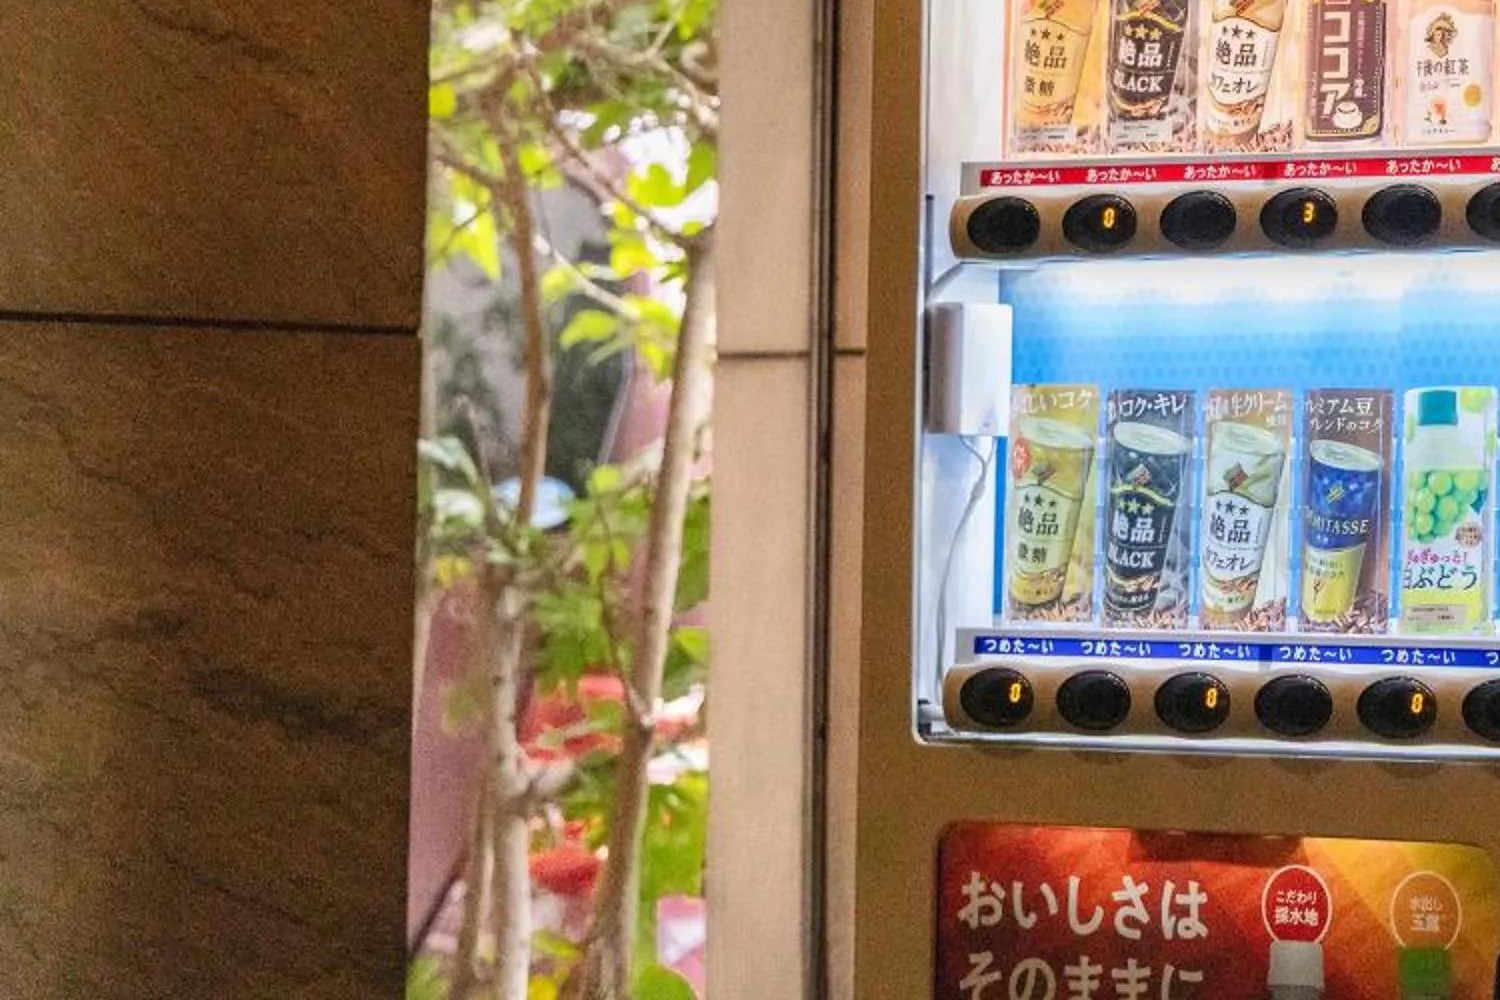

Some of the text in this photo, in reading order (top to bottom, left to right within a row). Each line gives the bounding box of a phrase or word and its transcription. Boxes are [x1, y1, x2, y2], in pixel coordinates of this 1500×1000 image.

[1023, 39, 1067, 69] 絶品
[1118, 37, 1163, 69] 絶品
[1215, 38, 1258, 68] 絶品
[1319, 10, 1351, 116] ココア
[1303, 202, 1315, 223] 3
[1017, 507, 1060, 537] 絶品
[1112, 509, 1155, 543] 絶品
[1209, 514, 1251, 544] 絶品
[1107, 543, 1156, 569] BLACK
[956, 871, 1210, 941] おいしさは
[1275, 889, 1317, 905] こだわり
[1274, 905, 1319, 926] 採水地
[959, 950, 1204, 1000] そのままに
